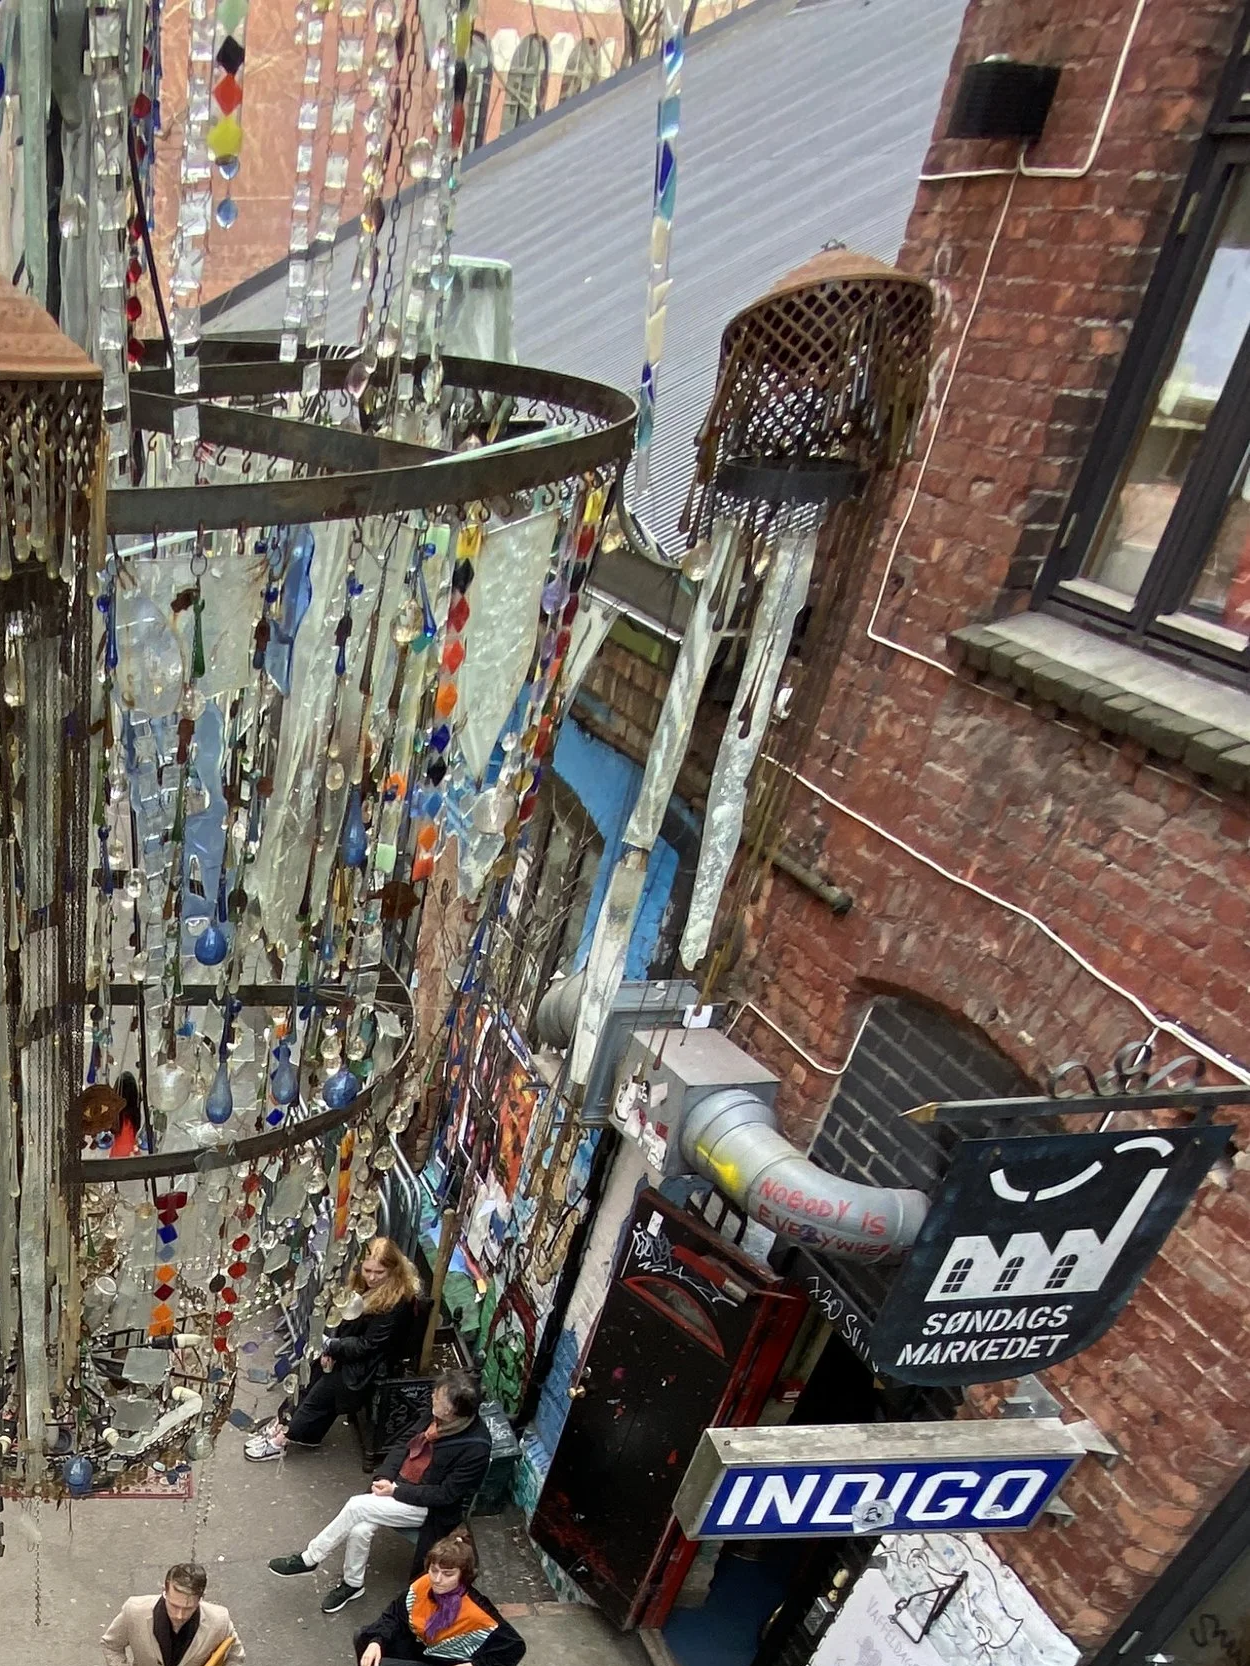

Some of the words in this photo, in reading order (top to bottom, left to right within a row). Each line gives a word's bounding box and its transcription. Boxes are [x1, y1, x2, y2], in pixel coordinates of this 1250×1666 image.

[758, 1176, 853, 1225] NOBODY
[861, 1209, 887, 1237] IS
[921, 1304, 1074, 1336] SØNDAGS
[895, 1333, 1070, 1367] MARKEDET
[716, 1468, 1049, 1527] INDIGO
